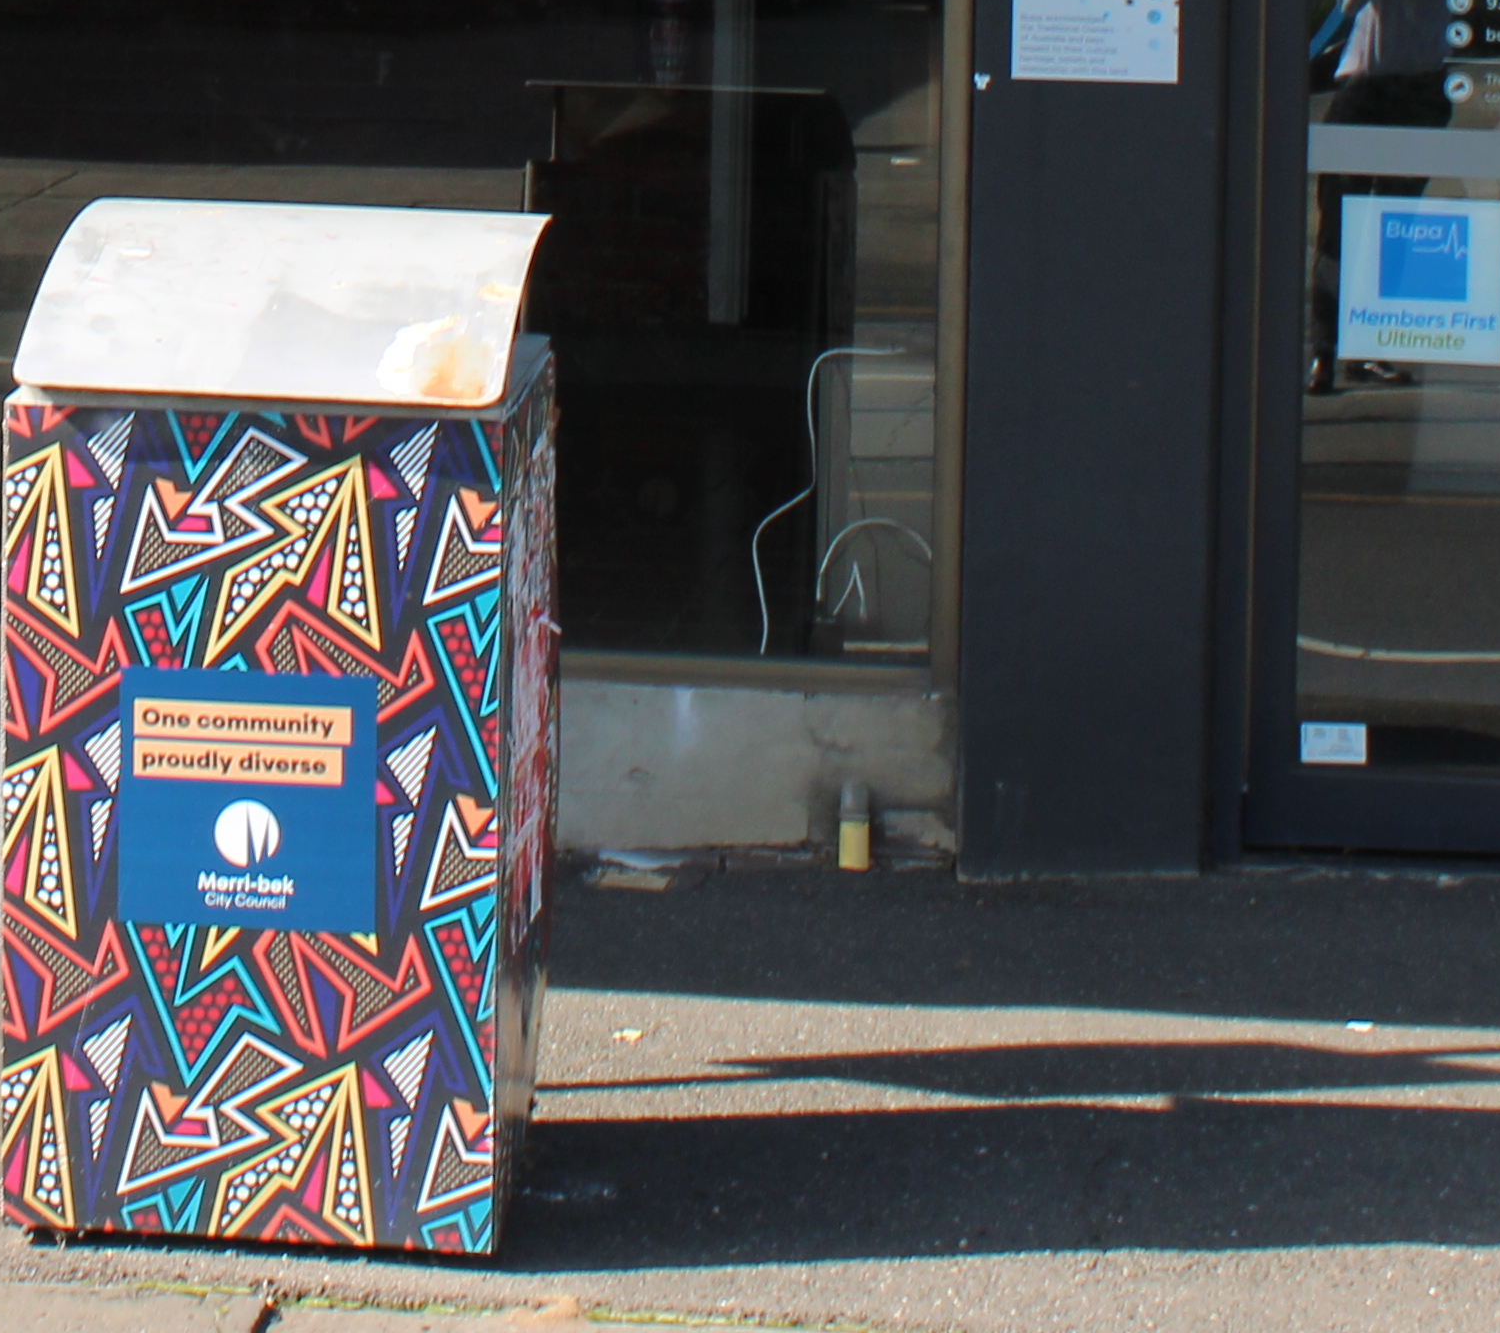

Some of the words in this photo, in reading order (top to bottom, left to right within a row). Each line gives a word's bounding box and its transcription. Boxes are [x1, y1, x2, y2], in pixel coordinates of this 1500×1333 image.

[1386, 219, 1443, 242] Bupa
[1348, 308, 1446, 329] Members
[1450, 311, 1497, 332] First
[1375, 328, 1466, 351] Ultimate
[140, 706, 189, 734] One
[195, 710, 336, 740] community
[140, 748, 234, 779] proudly
[238, 750, 329, 778] diverse
[196, 870, 297, 897] Merri-bek
[204, 892, 236, 912] City
[234, 893, 289, 913] Council
